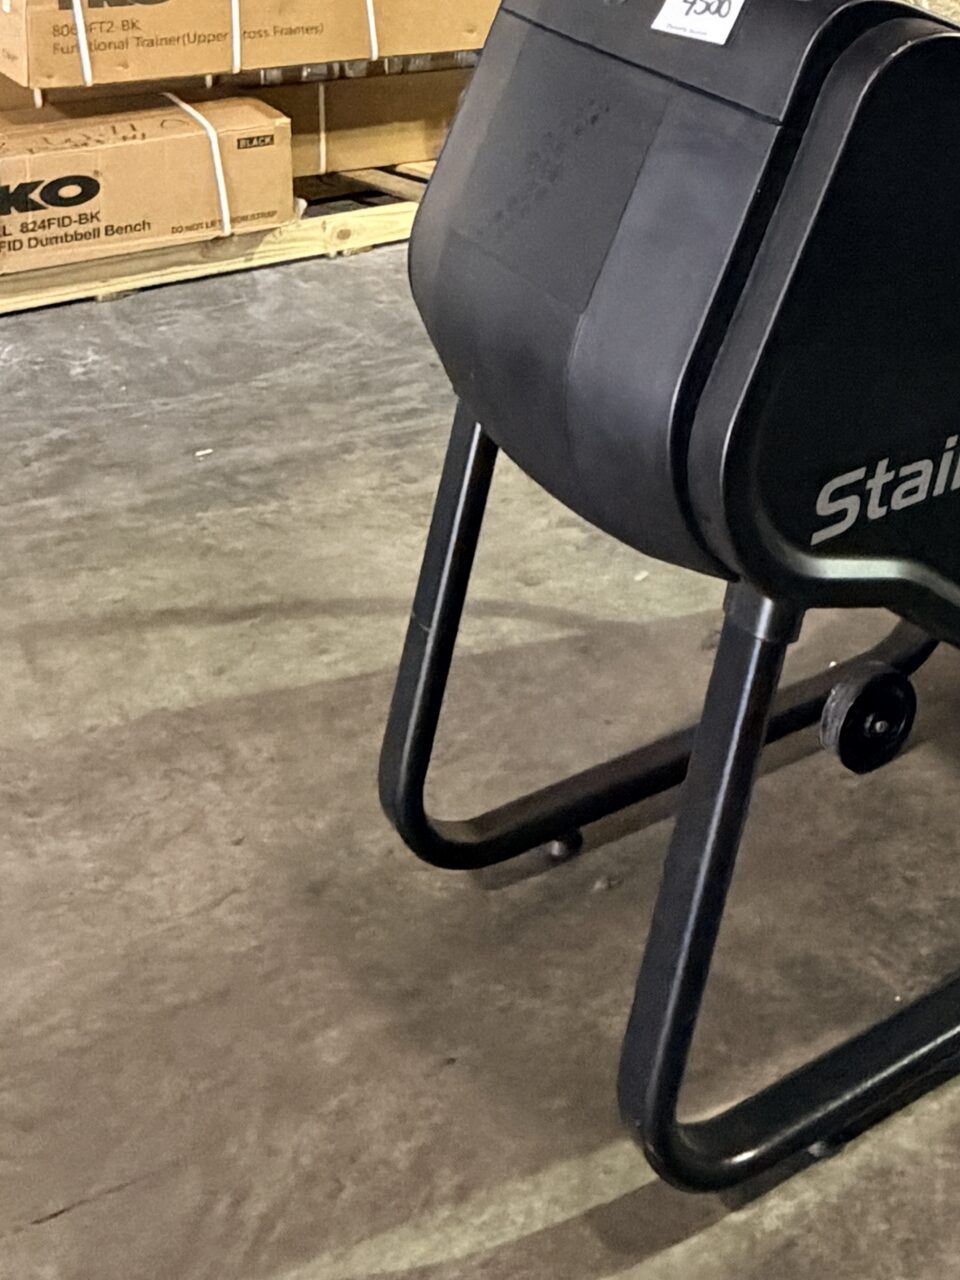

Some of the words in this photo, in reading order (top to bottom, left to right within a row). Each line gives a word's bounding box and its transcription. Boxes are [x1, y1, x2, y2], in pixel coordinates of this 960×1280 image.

[239, 28, 270, 41] ross
[238, 135, 274, 149] BLACK
[20, 210, 101, 234] 824FID-BK
[28, 227, 101, 250] Dumbbell
[104, 221, 151, 237] Bench
